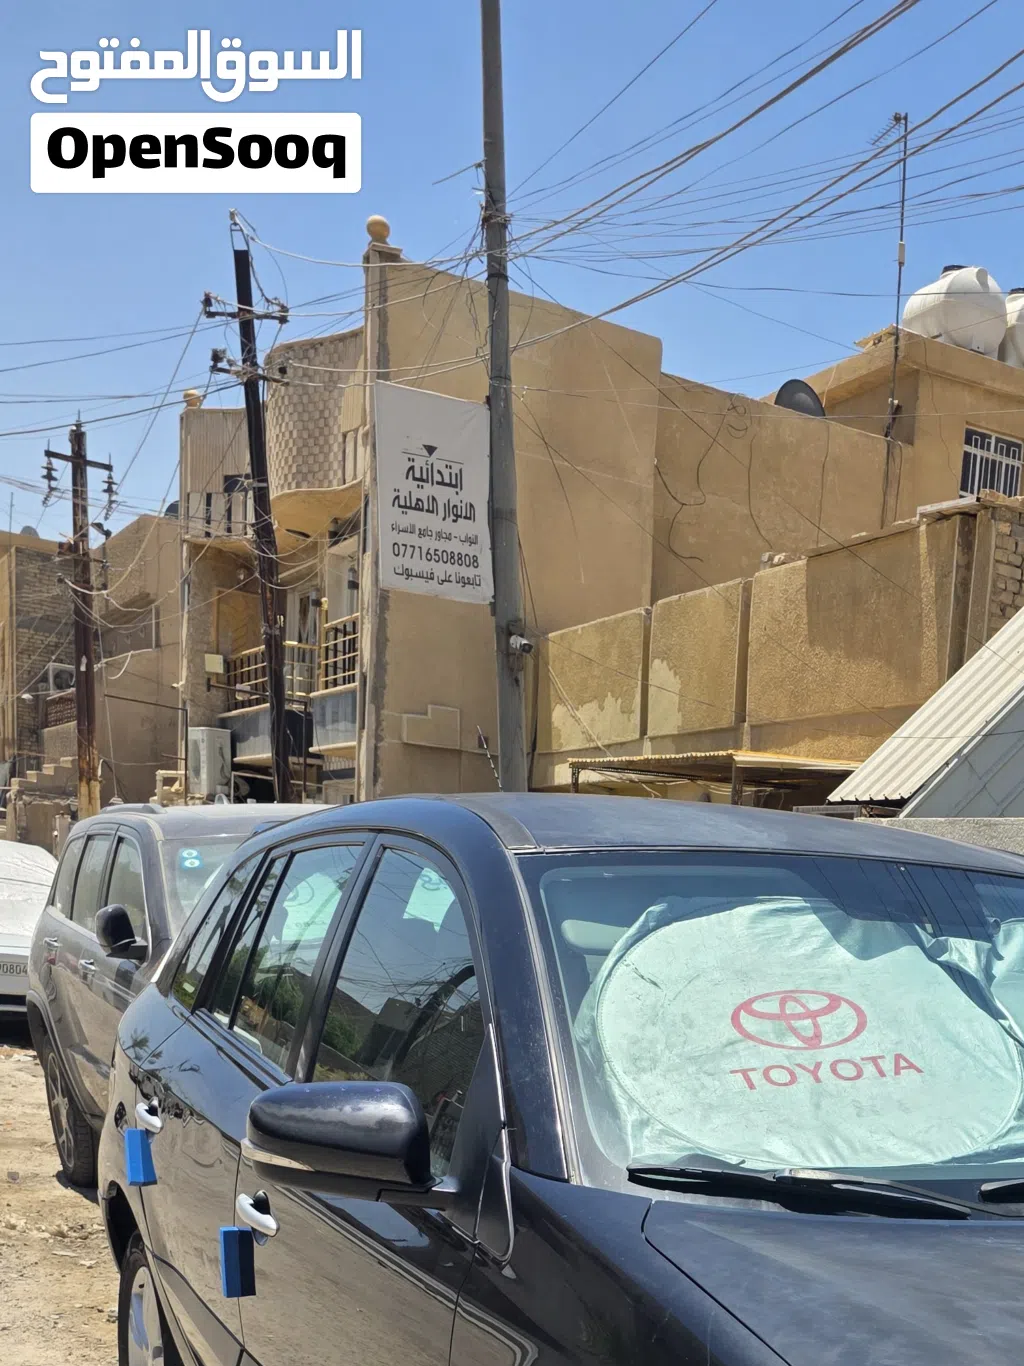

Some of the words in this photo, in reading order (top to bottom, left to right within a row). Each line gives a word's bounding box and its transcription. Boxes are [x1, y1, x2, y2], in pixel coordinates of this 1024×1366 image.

[405, 456, 463, 496] ابتدائية
[392, 487, 438, 517] الاهلية
[442, 498, 476, 524] الانوار
[418, 525, 433, 540] جامع
[435, 528, 452, 543] مجاور
[392, 541, 479, 569] 07716508808
[393, 563, 435, 584] فيسبوك
[437, 569, 453, 586] على
[455, 571, 481, 589] تابعونا
[0, 963, 28, 975] 0804
[729, 1052, 925, 1091] TOYOTA
